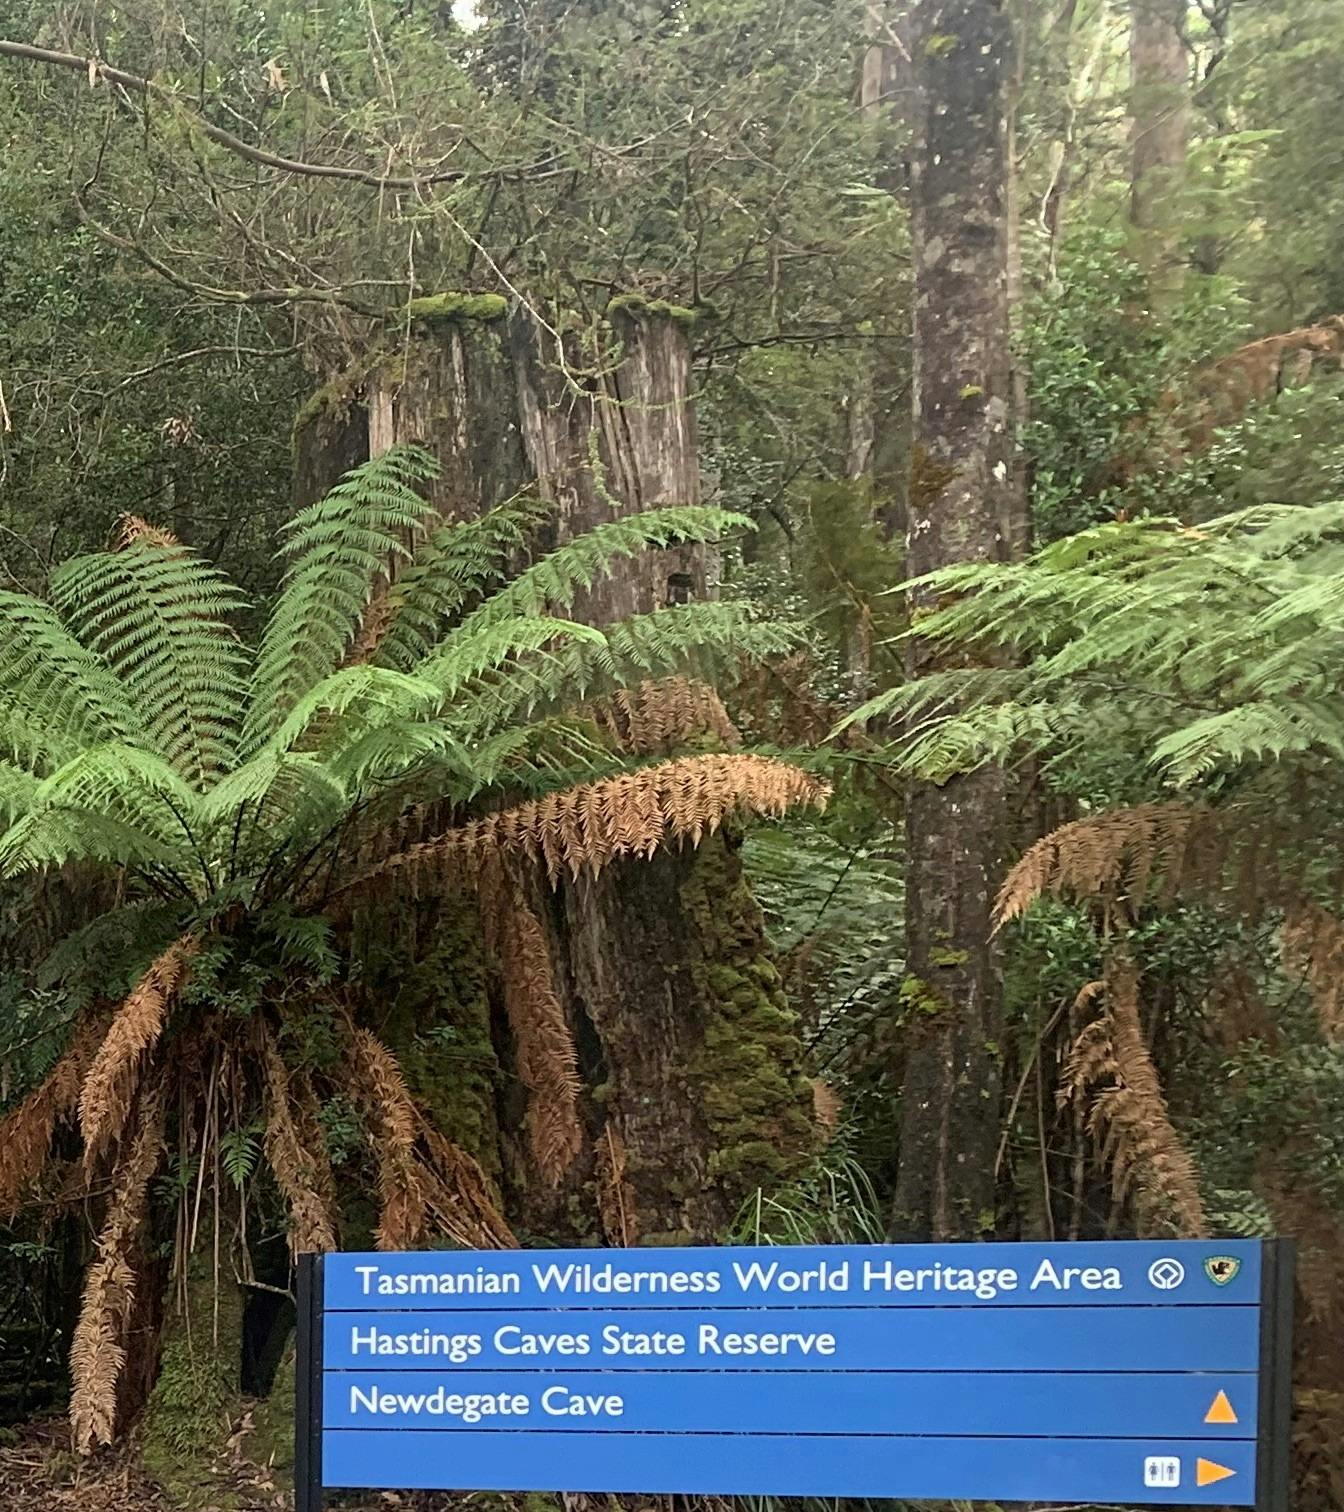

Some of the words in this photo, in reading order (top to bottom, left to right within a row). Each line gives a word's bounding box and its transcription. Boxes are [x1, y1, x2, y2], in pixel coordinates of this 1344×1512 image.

[354, 1266, 520, 1295] Tasmanian
[531, 1263, 721, 1293] Wilderness
[732, 1261, 849, 1292] World
[863, 1261, 1018, 1300] Heritage
[1030, 1259, 1123, 1291] Area
[351, 1326, 482, 1363] Hastings
[493, 1326, 591, 1356] Caves
[602, 1325, 685, 1355] State
[699, 1325, 837, 1355] Reserve
[350, 1385, 530, 1423] Newdegate
[541, 1386, 625, 1417] Cave
